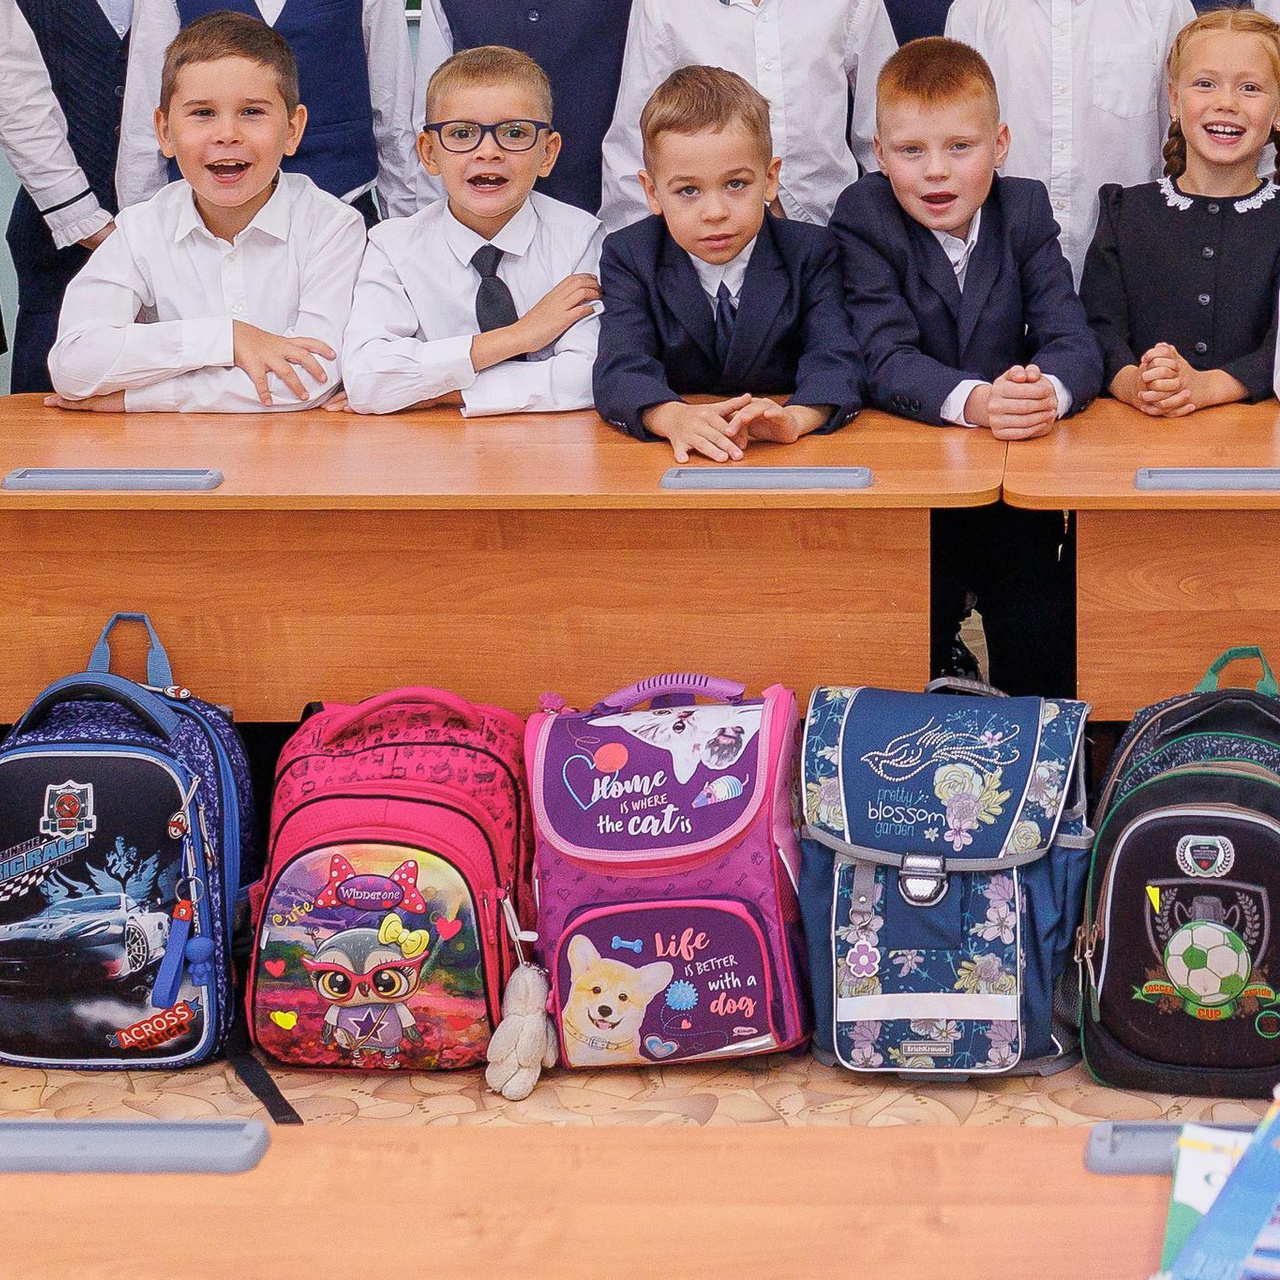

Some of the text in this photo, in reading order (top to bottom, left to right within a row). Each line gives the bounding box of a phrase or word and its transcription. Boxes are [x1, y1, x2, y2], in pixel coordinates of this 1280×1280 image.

[592, 770, 668, 803] Home
[876, 786, 914, 807] pretty
[620, 793, 668, 814] IS WHERE
[868, 800, 946, 827] blossom
[597, 803, 692, 837] the cat is
[875, 821, 915, 838] garden
[0, 832, 87, 880] IG RACE
[272, 899, 315, 929] Cute
[655, 927, 710, 961] Life
[684, 954, 738, 977] IS BETTER
[708, 971, 757, 991] with a
[1144, 983, 1175, 996] SOCCER
[710, 992, 757, 1018] dog
[1197, 1007, 1222, 1020] CUP
[121, 1005, 189, 1045] ACROSS
